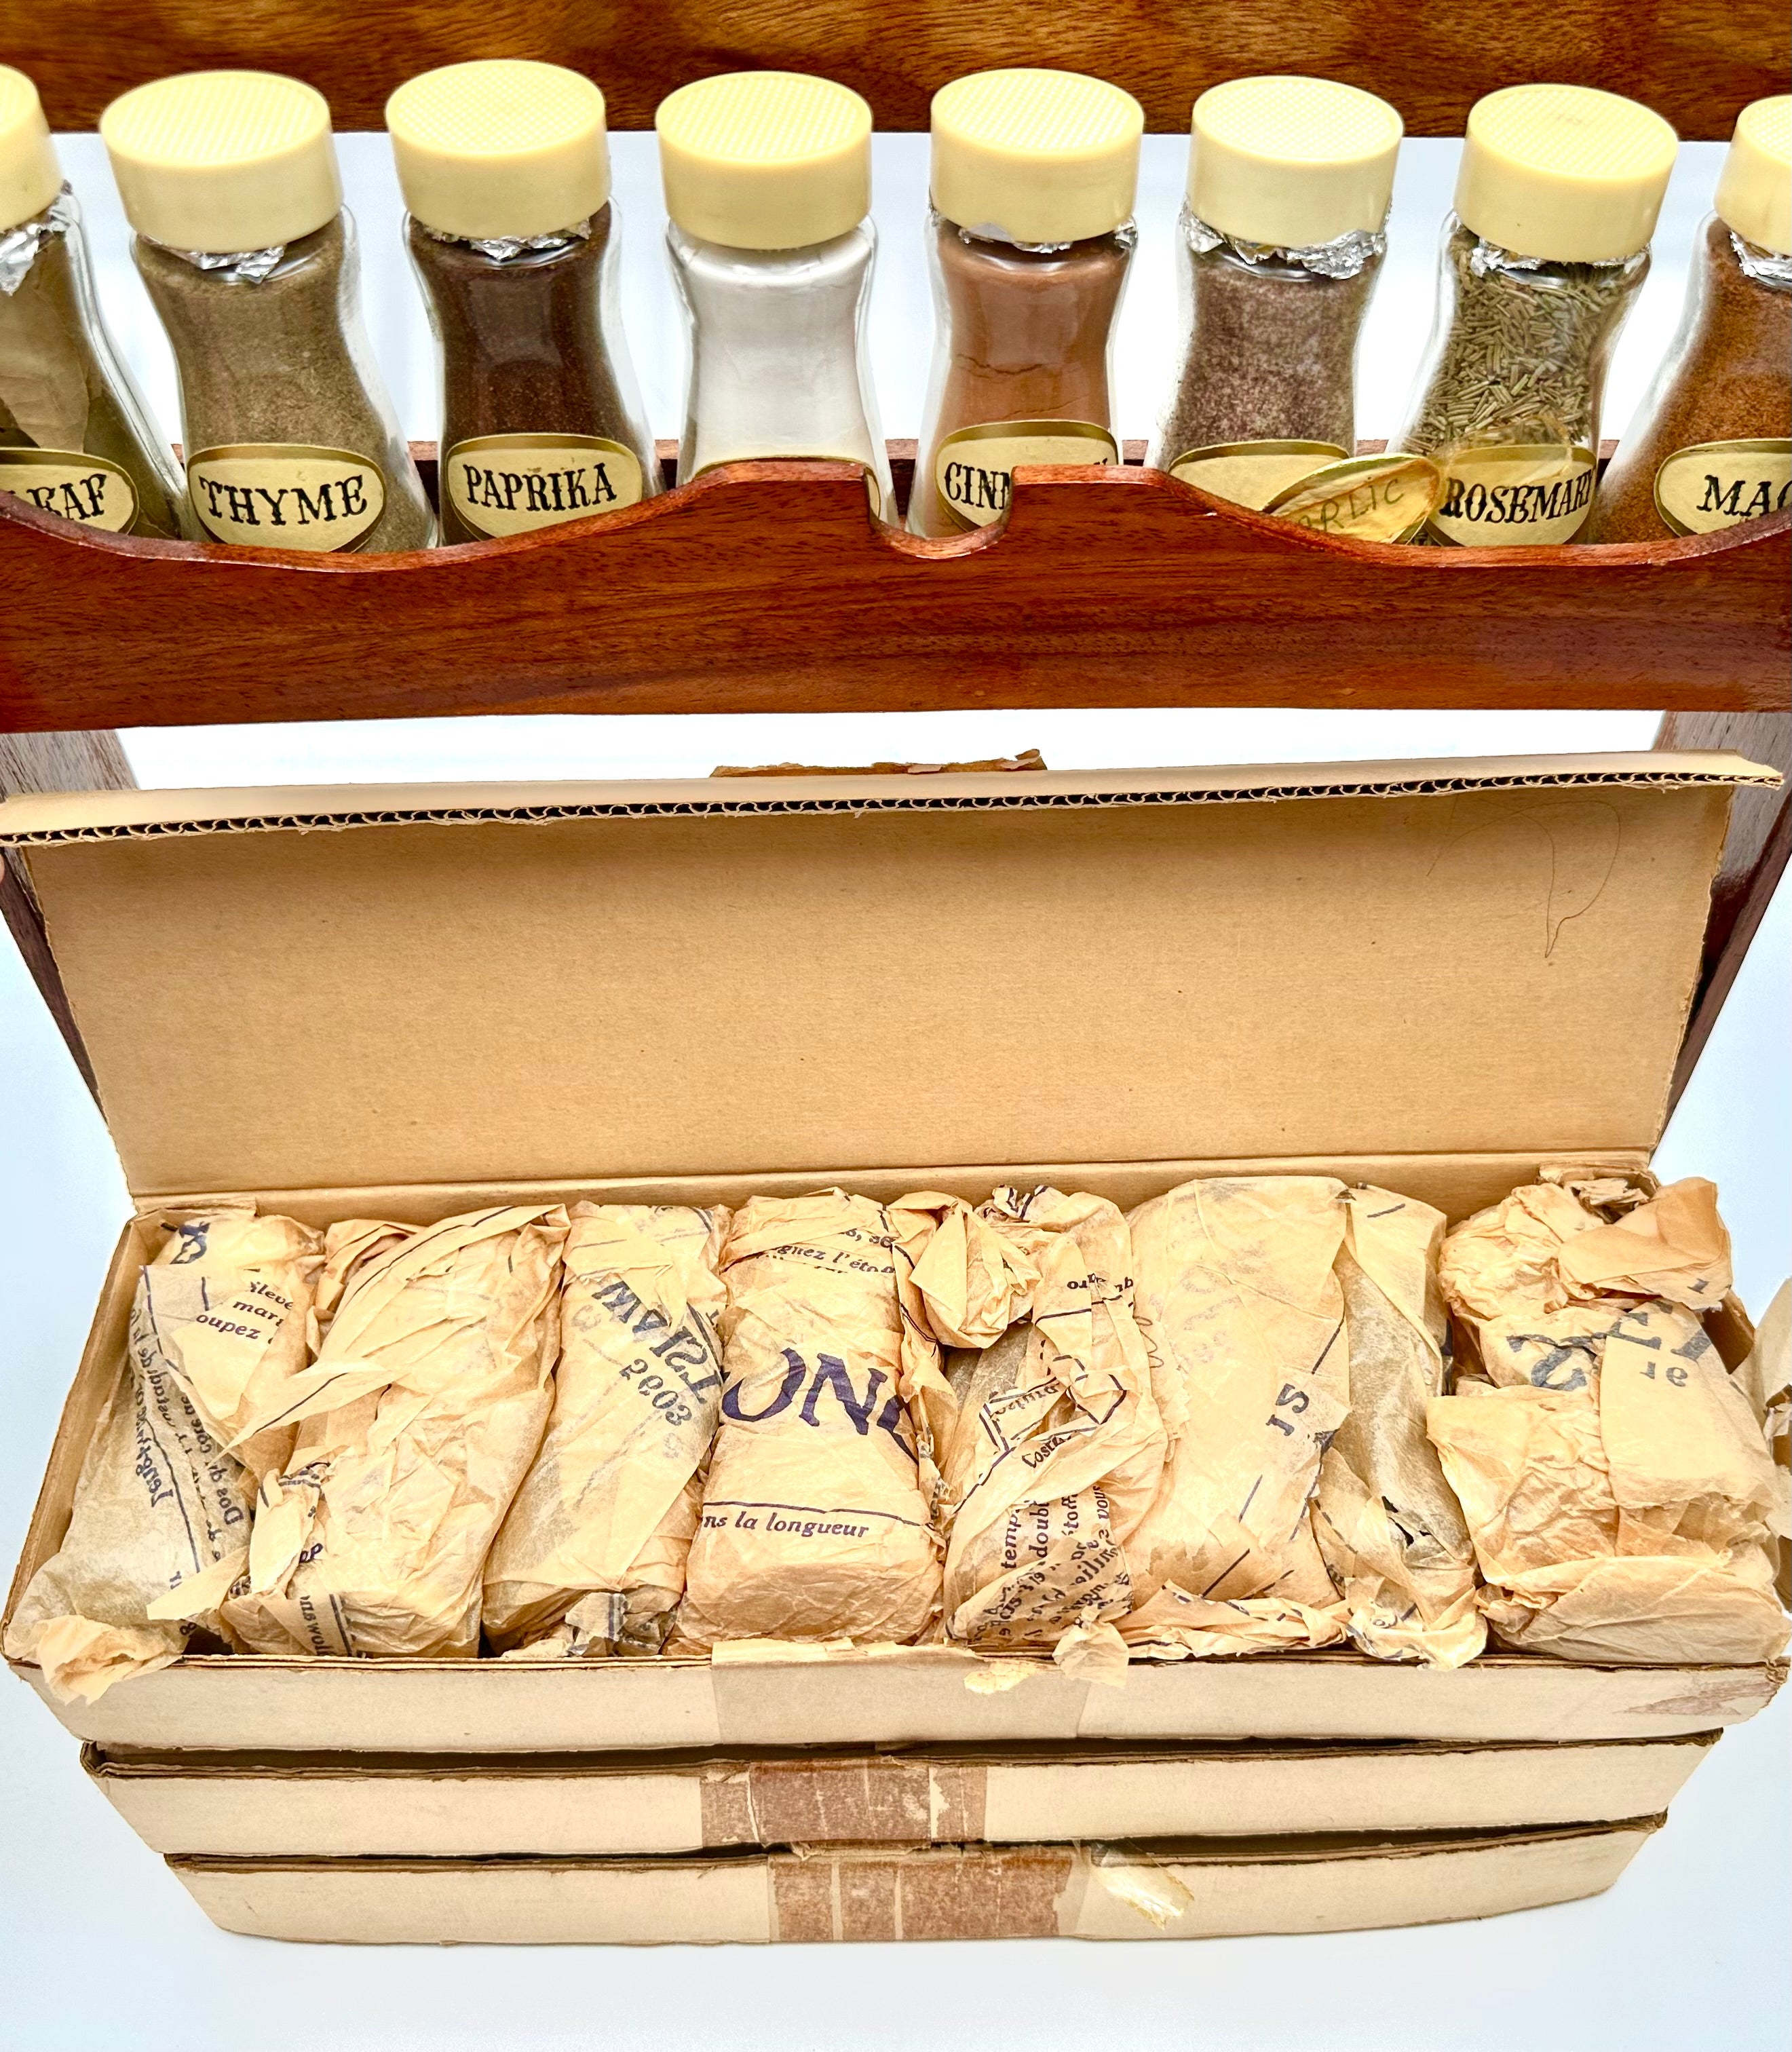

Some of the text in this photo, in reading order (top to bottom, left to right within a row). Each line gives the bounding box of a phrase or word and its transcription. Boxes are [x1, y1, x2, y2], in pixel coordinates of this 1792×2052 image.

[8, 474, 107, 521] EAF
[199, 475, 368, 526] THYME
[463, 463, 617, 512] PAPRIKA
[1439, 469, 1592, 524] ROSEMARY
[777, 1244, 824, 1260] gnez
[195, 1314, 261, 1340] oupez
[735, 1510, 759, 1530] la
[765, 1512, 870, 1538] longueur
